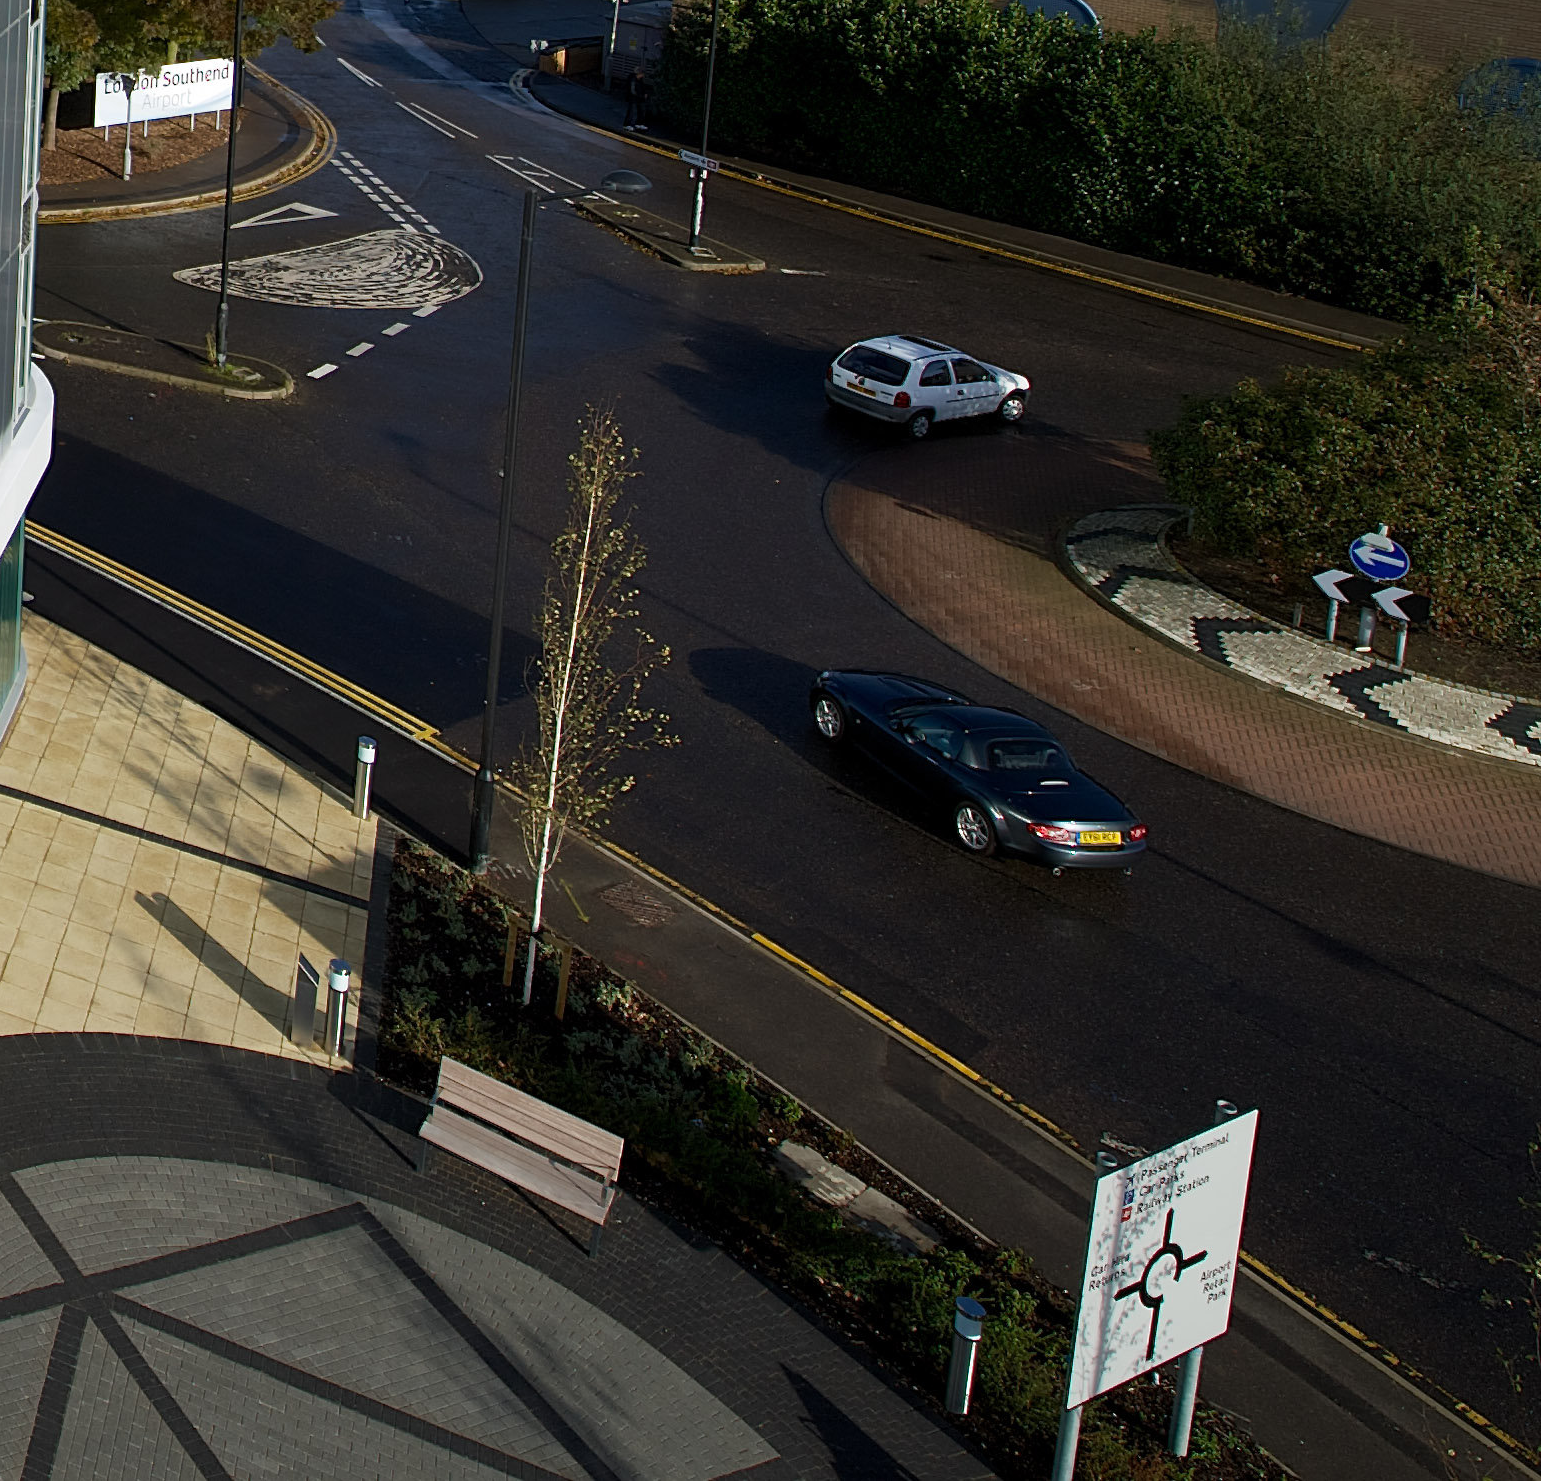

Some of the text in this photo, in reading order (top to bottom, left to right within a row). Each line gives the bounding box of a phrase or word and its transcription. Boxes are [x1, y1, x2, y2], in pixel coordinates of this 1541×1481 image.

[104, 64, 230, 95] Loon Southend
[142, 90, 192, 111] Airport
[1140, 1132, 1229, 1181] Passenger Terminal
[1158, 1169, 1185, 1187] Parks
[1136, 1175, 1210, 1214] Railway Station
[1200, 1260, 1231, 1283] Airport
[1203, 1273, 1228, 1293] Retail
[1207, 1288, 1226, 1304] Park
